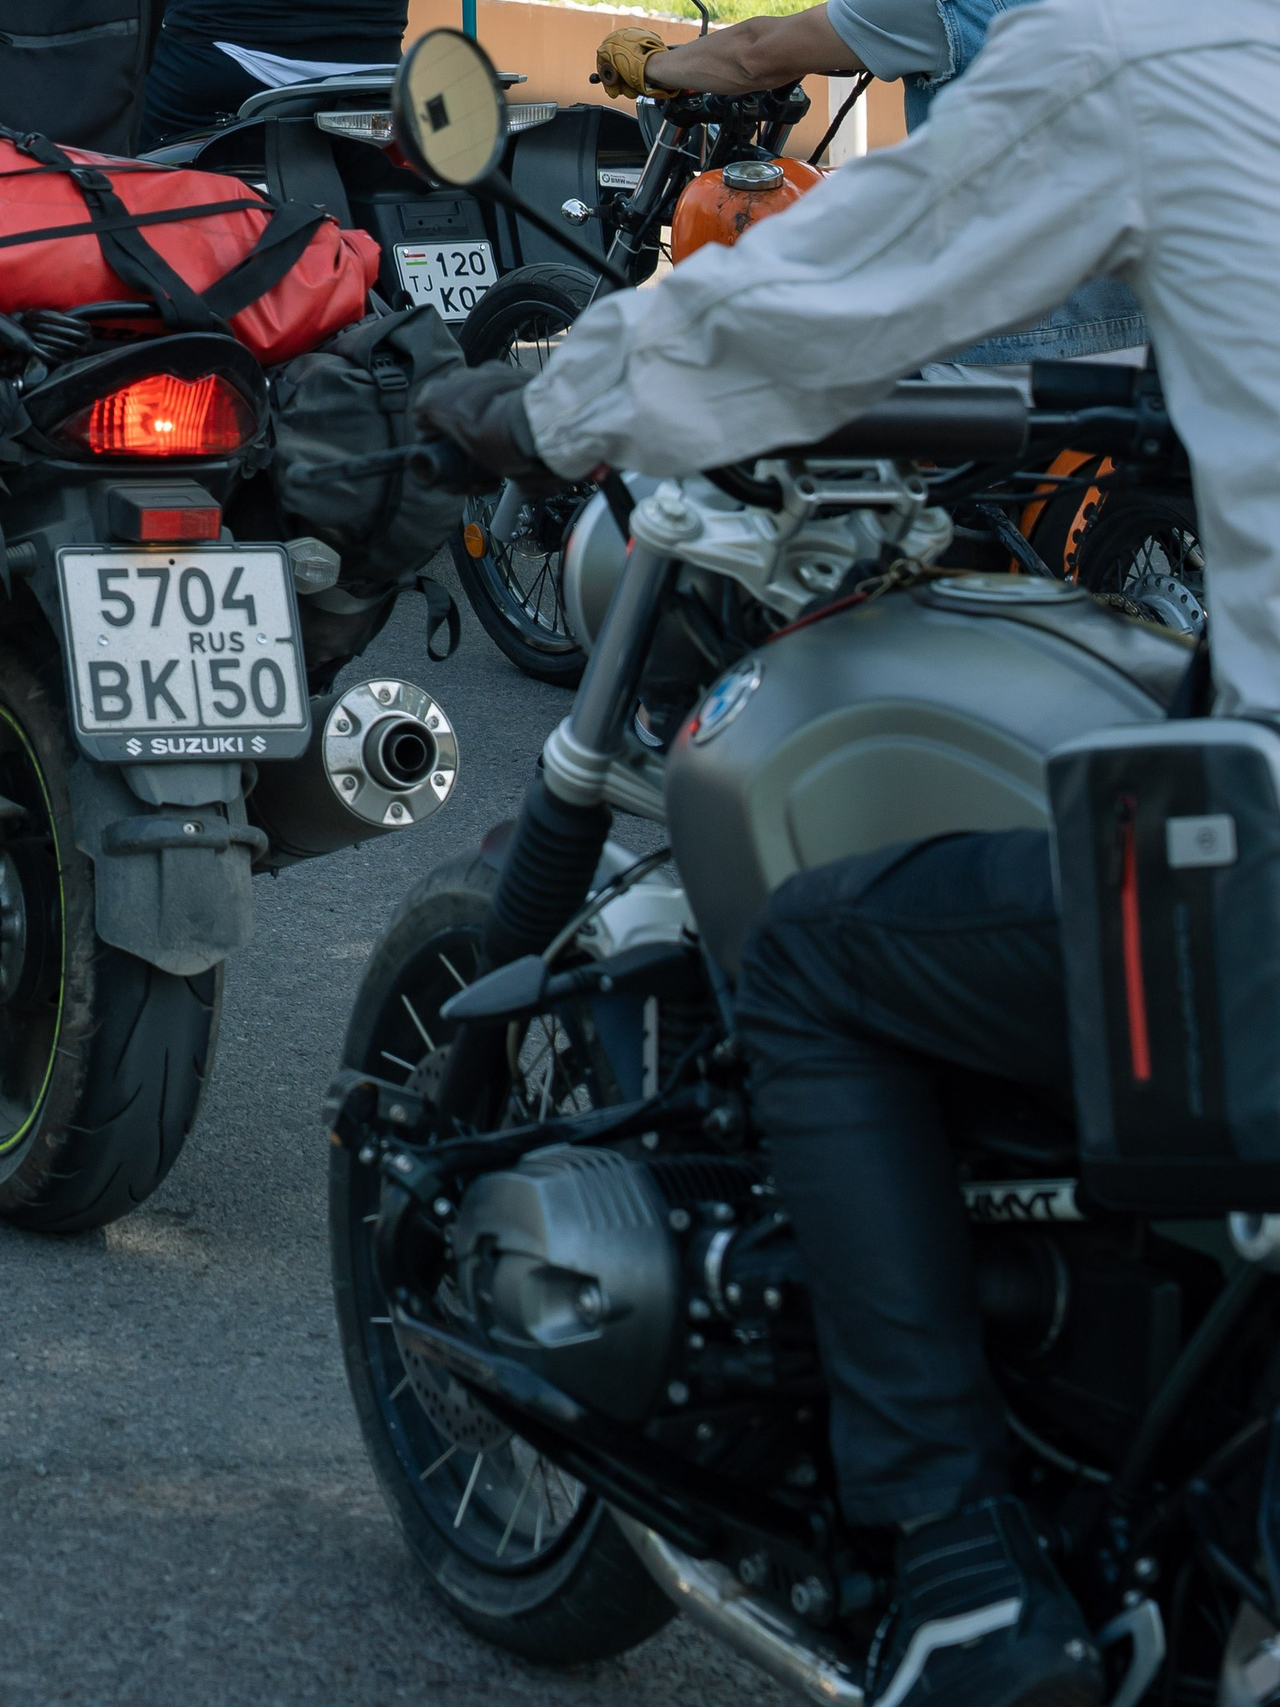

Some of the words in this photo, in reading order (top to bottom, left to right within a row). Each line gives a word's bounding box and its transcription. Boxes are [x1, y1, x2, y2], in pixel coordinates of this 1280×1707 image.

[436, 251, 486, 277] 120
[409, 275, 433, 293] TJ
[97, 566, 257, 628] 5704
[188, 631, 245, 654] RUS
[88, 659, 187, 721] BK
[209, 658, 286, 718] 50
[150, 737, 244, 754] SUZUKI
